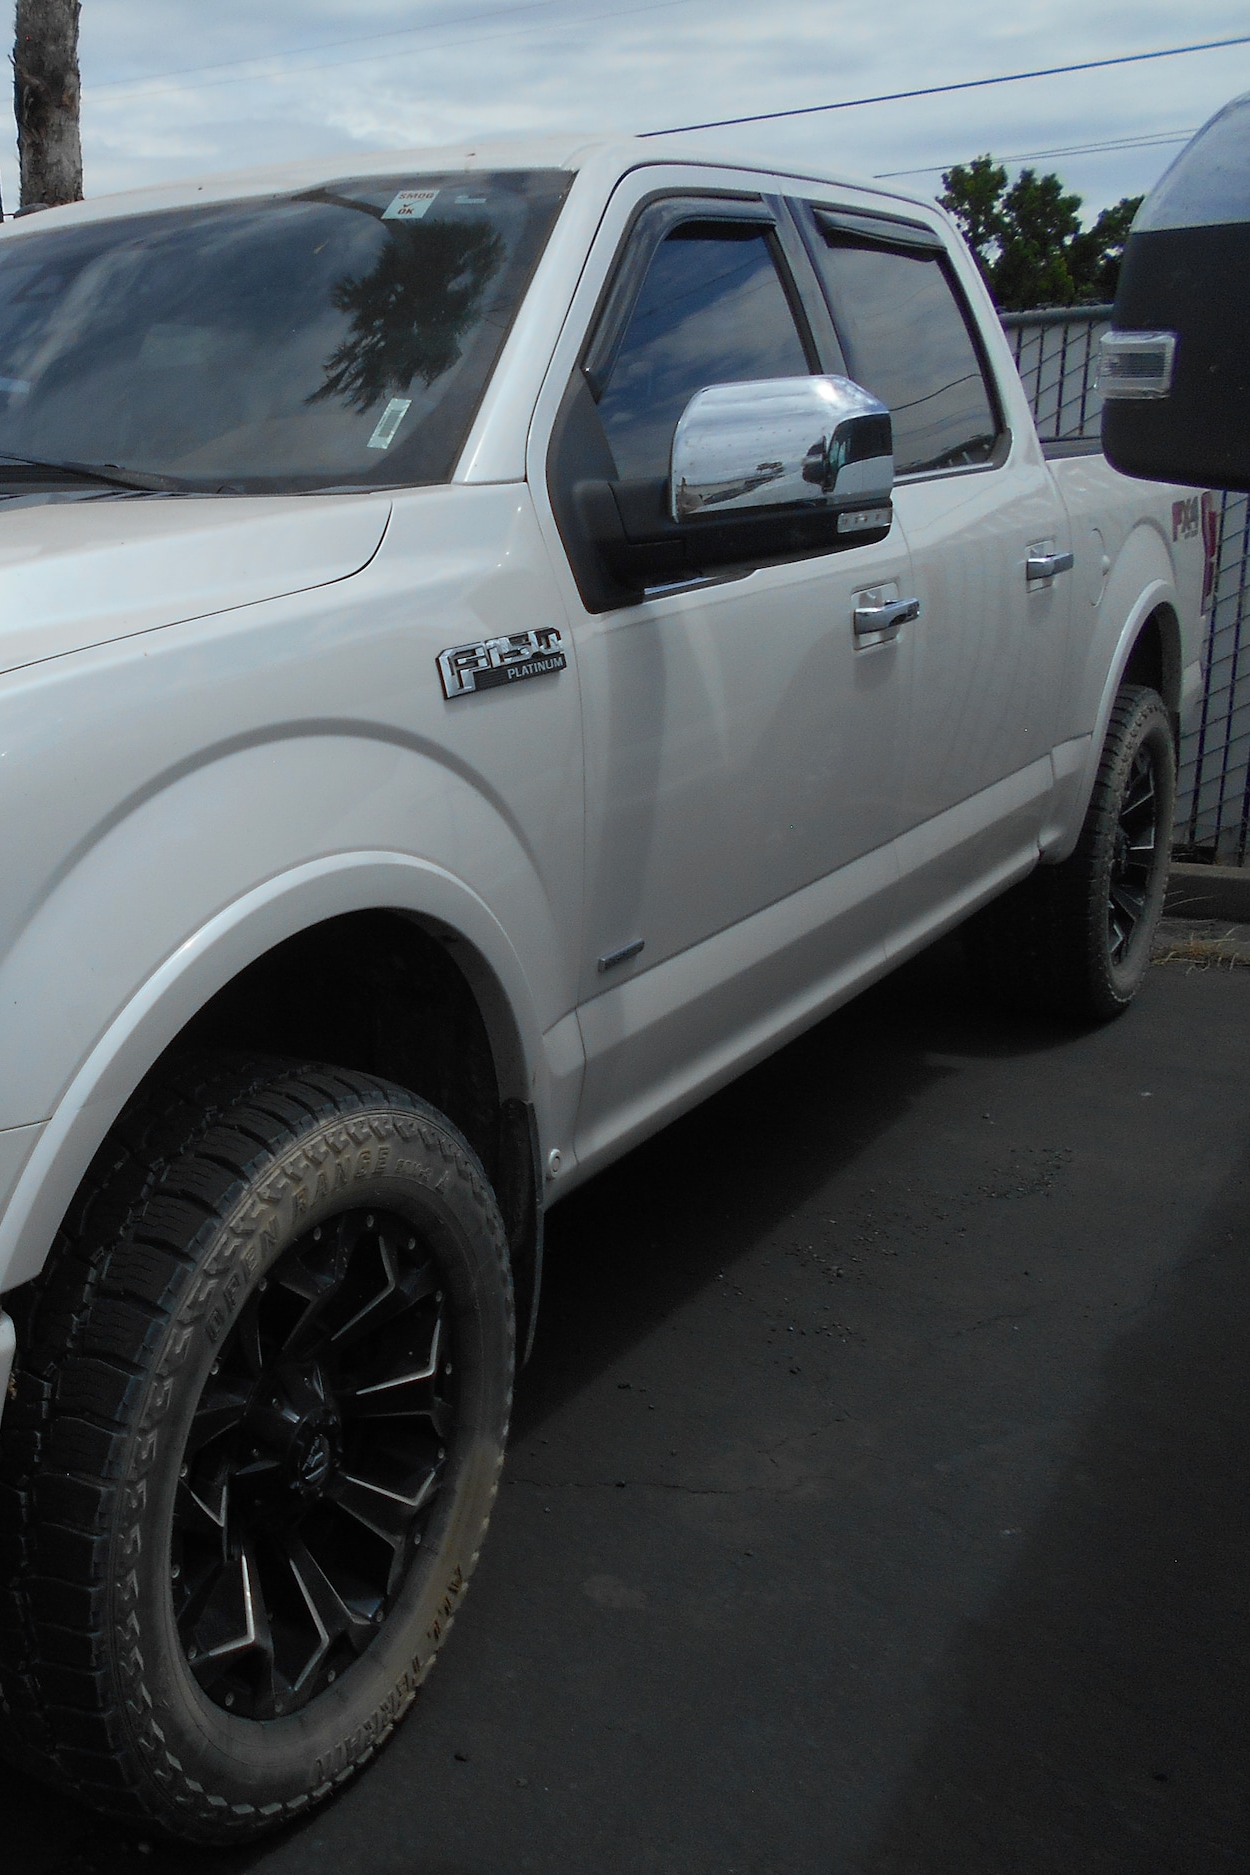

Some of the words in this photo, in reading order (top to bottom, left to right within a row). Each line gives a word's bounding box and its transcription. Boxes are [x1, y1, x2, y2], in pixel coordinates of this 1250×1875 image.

[398, 192, 435, 200] SMOG
[1172, 496, 1199, 542] FX4
[507, 656, 564, 680] PLATINUM
[204, 1213, 281, 1345] OPEN
[292, 1144, 391, 1222] RANGE
